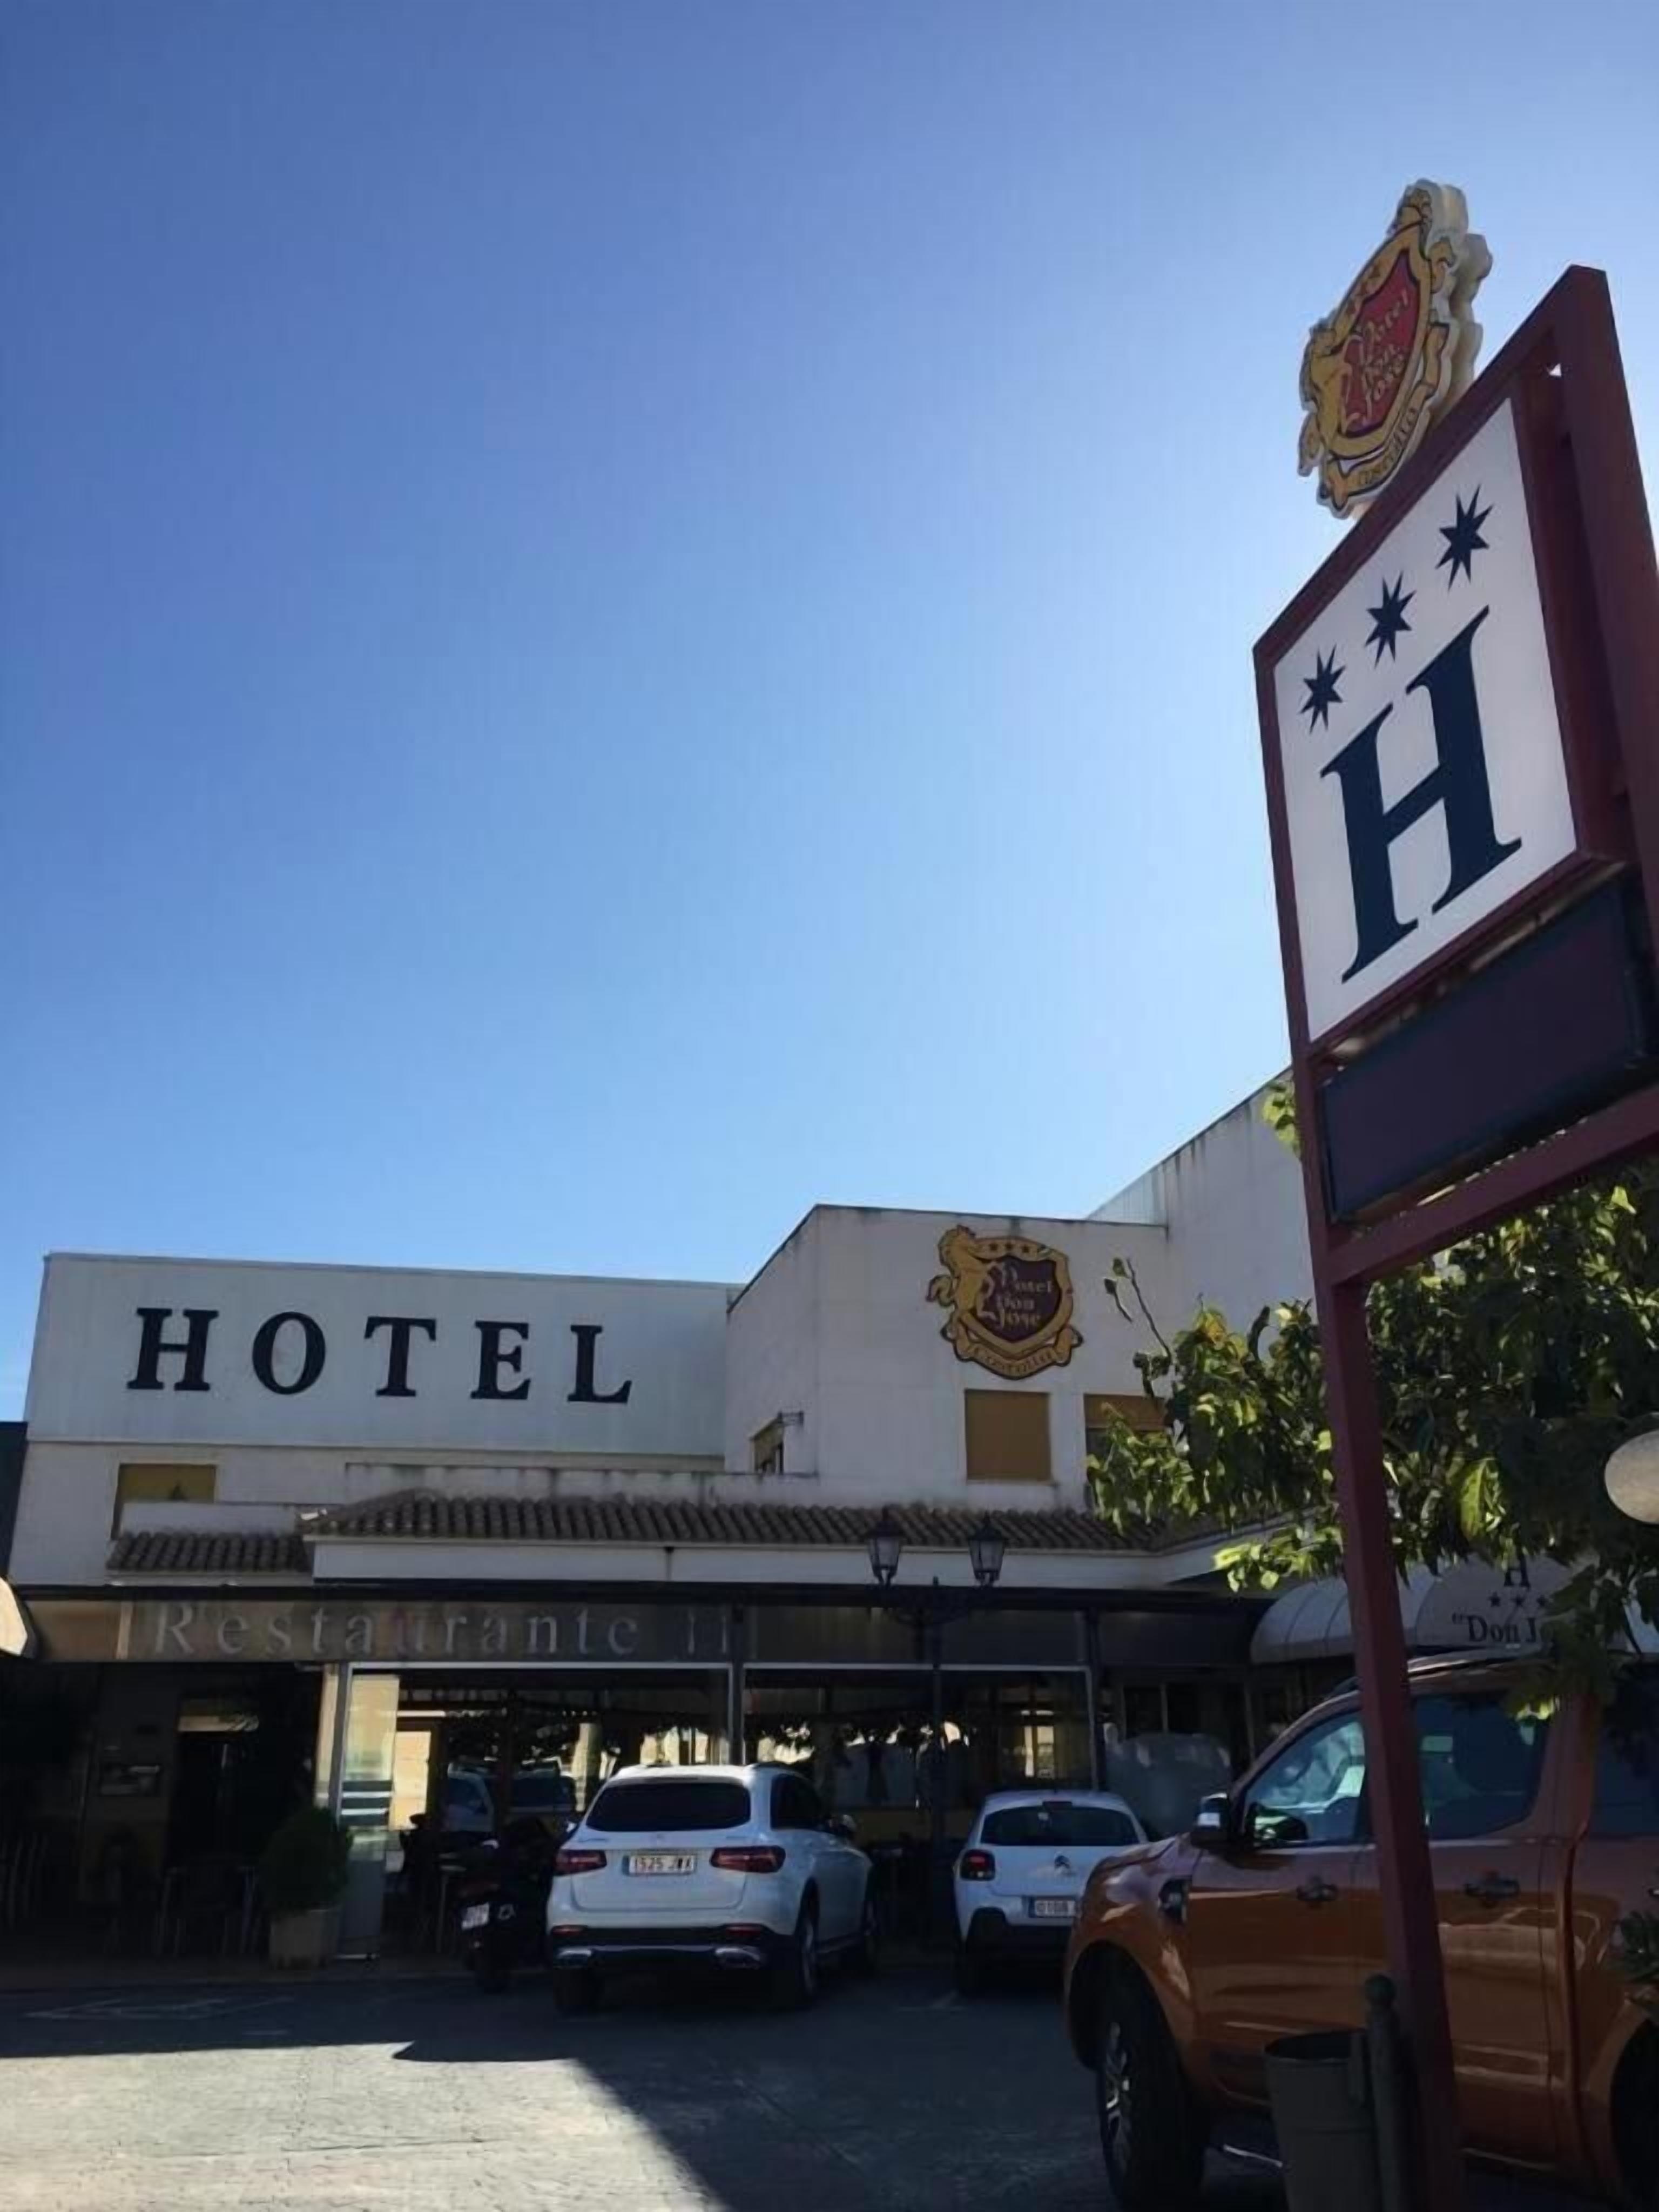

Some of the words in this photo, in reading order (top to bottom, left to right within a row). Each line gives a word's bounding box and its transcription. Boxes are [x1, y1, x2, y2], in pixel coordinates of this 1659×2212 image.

[1320, 605, 1522, 984] H
[127, 1307, 632, 1403] HOTEL
[153, 1605, 640, 1655] Restaurante
